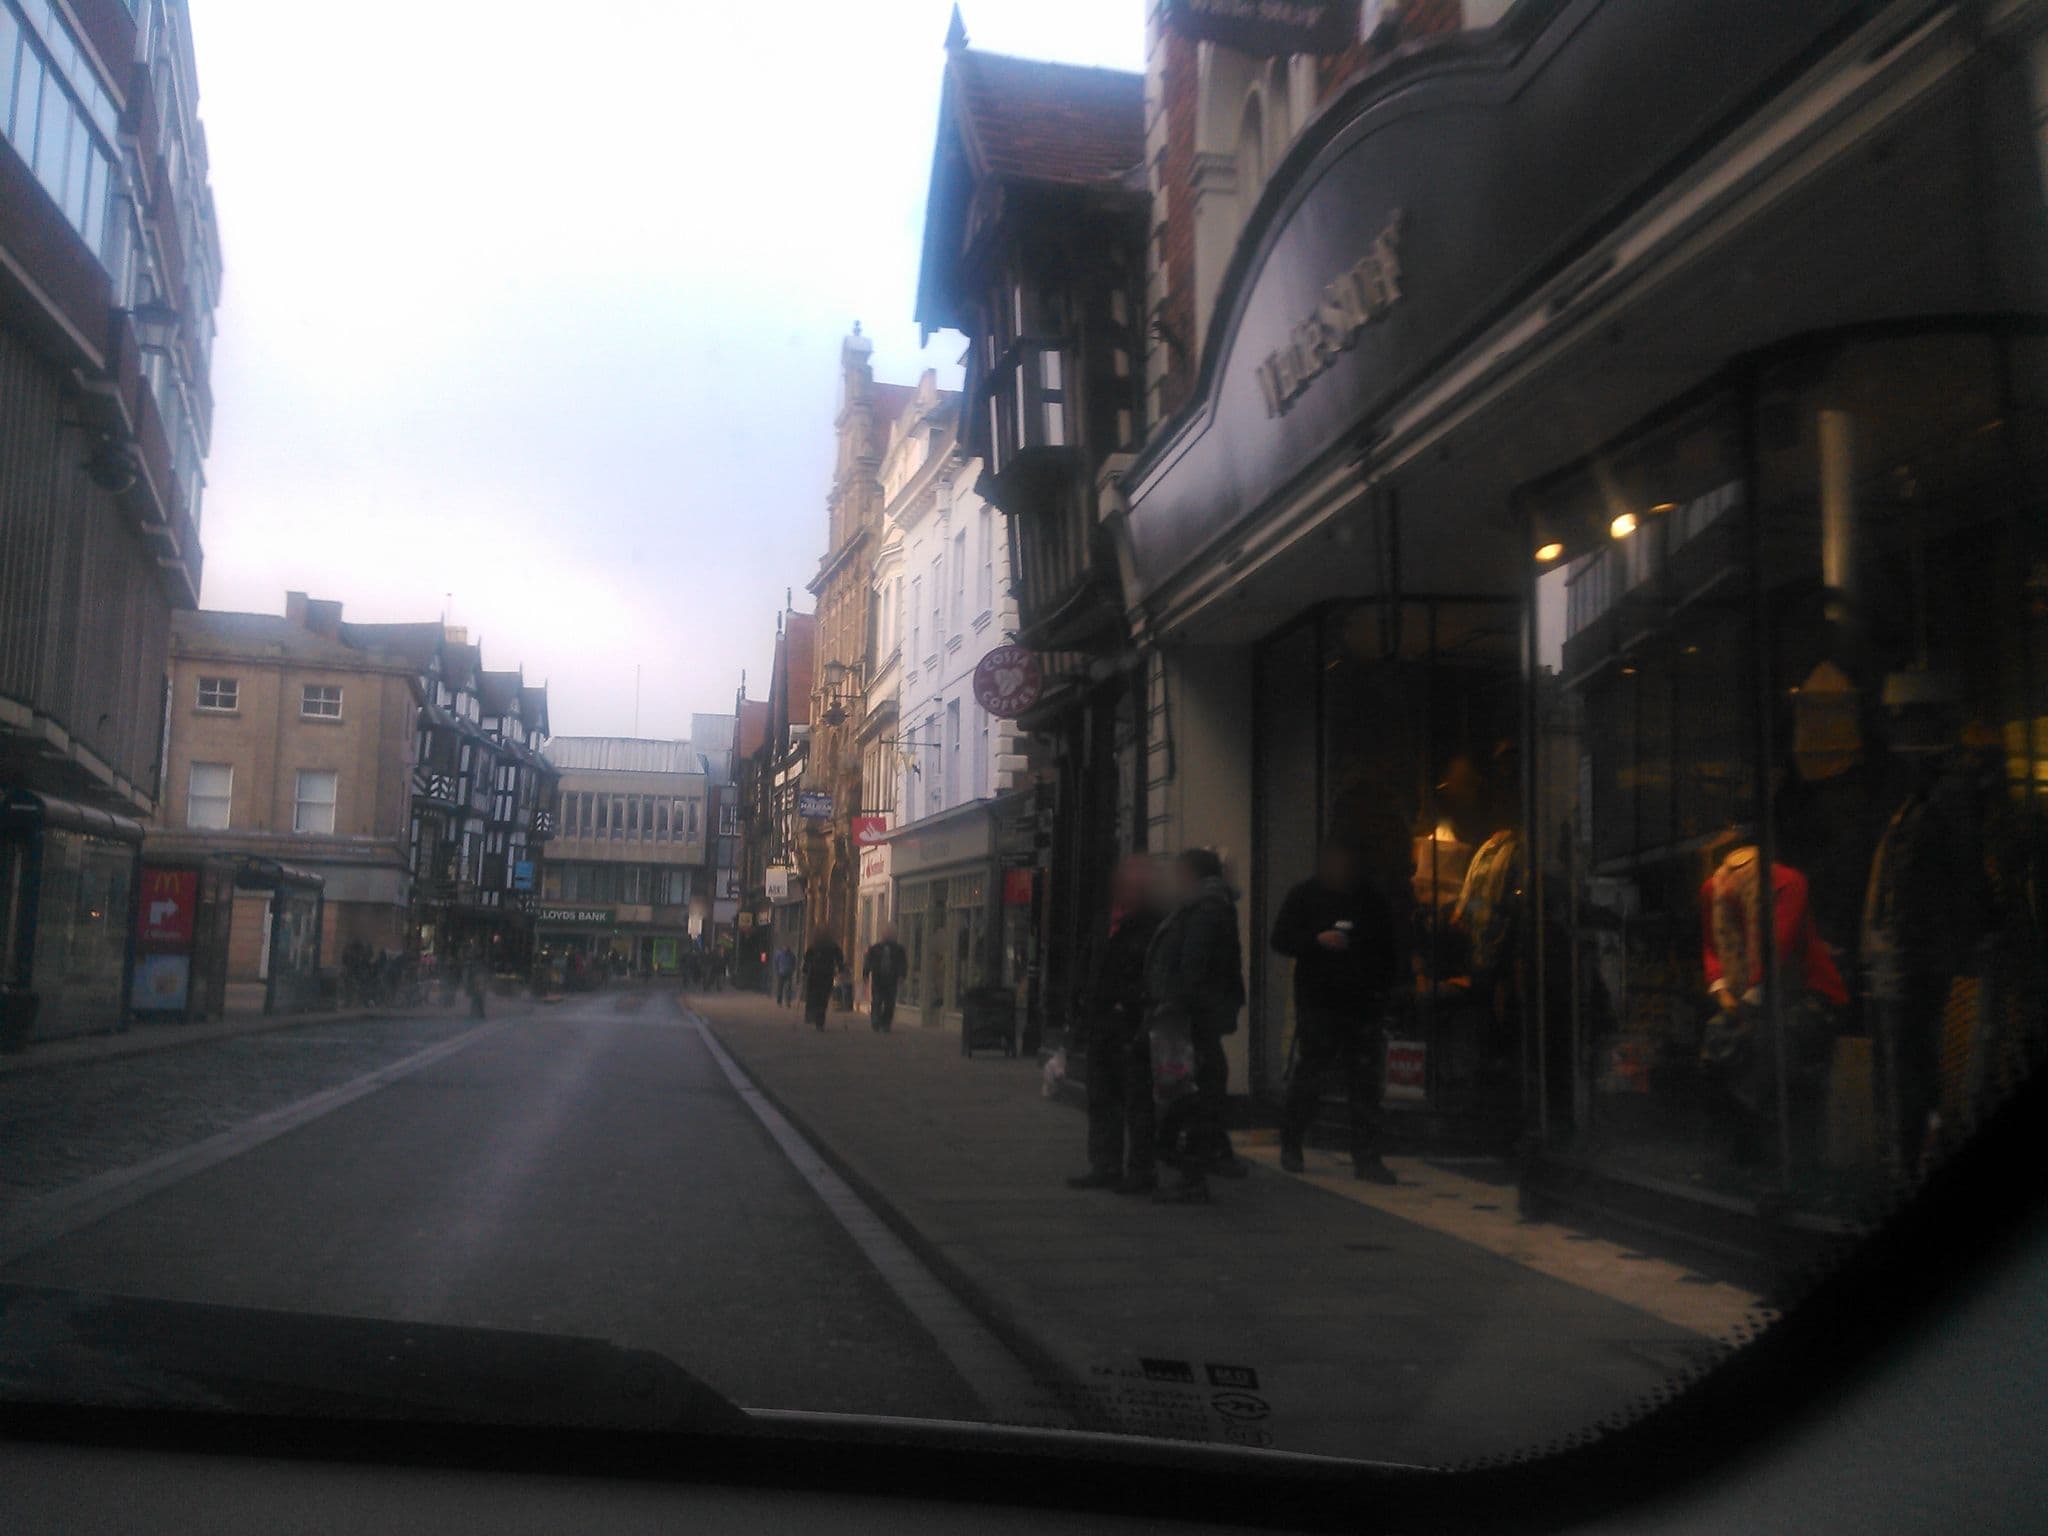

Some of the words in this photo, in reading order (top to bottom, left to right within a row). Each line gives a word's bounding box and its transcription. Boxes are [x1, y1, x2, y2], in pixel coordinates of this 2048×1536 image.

[983, 650, 1031, 671] COSTA
[983, 687, 1035, 711] COFFEE
[578, 911, 607, 921] BANK
